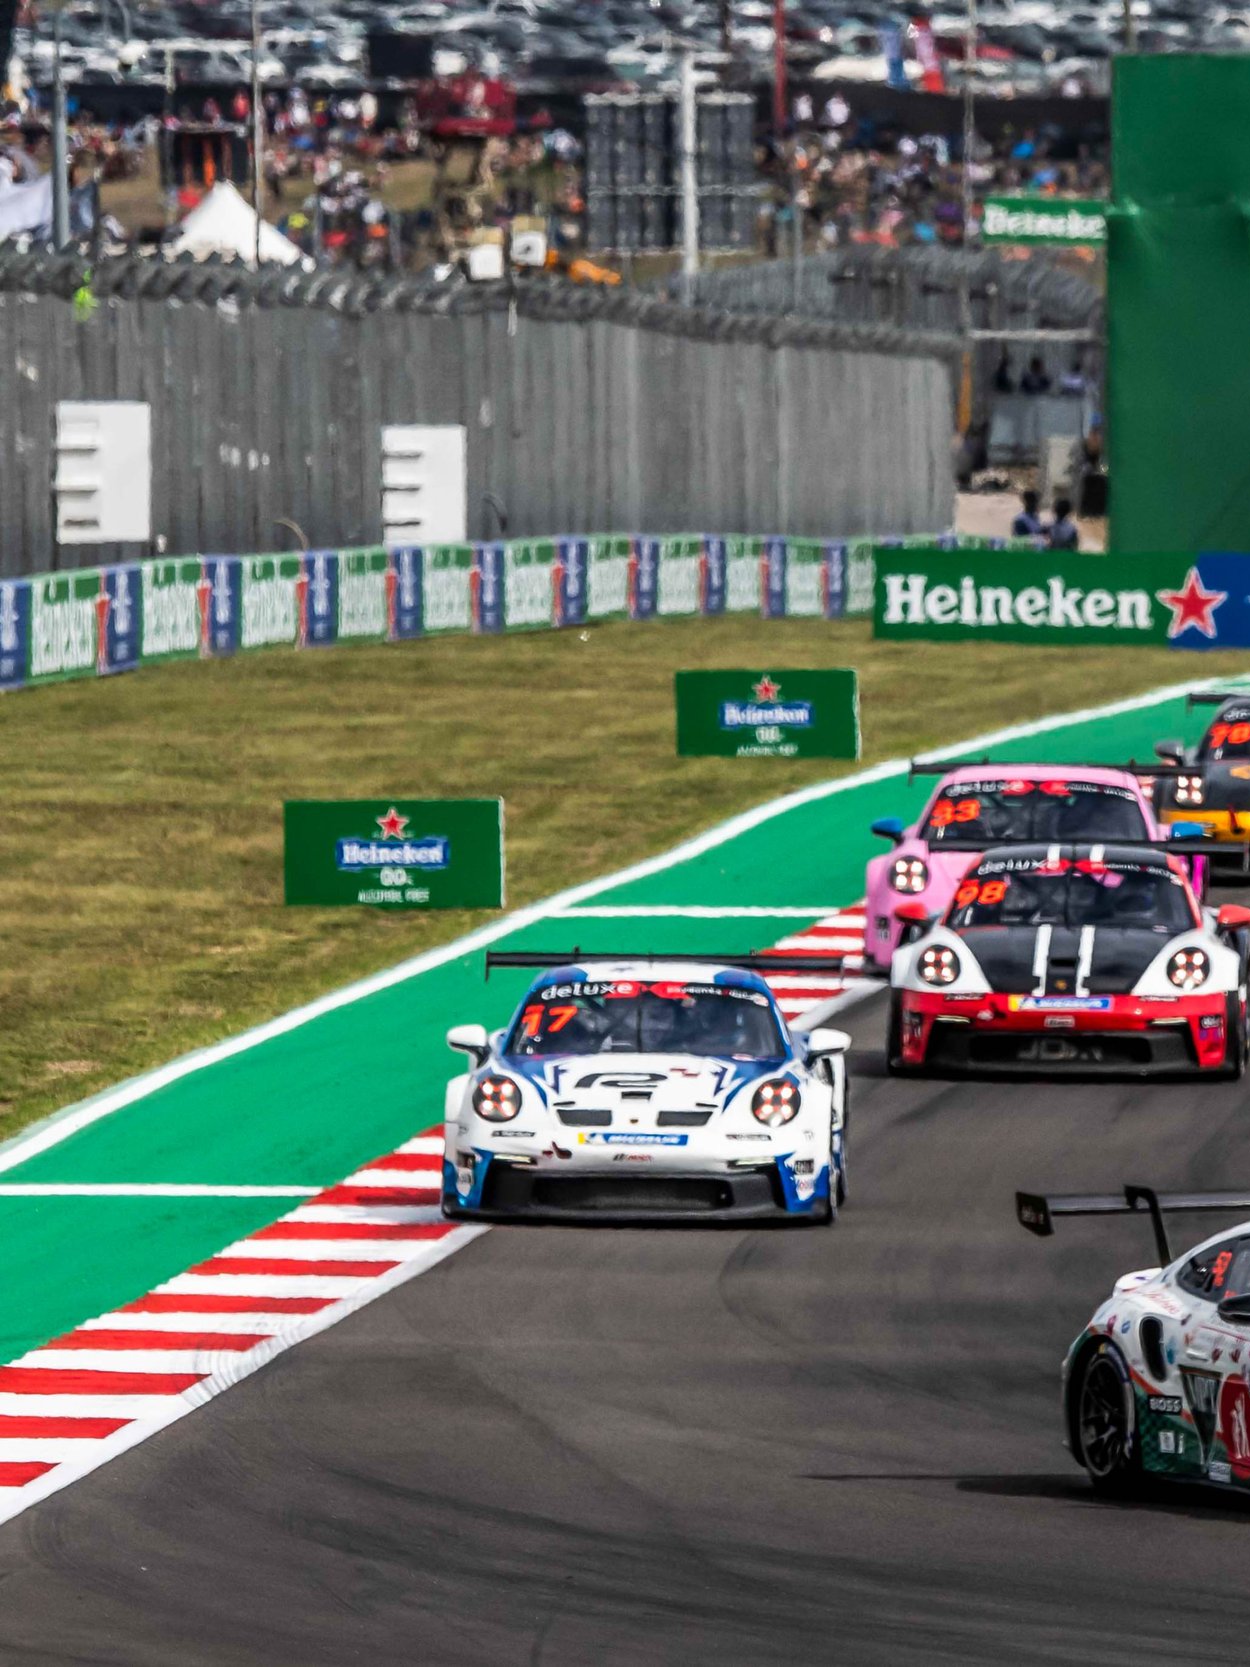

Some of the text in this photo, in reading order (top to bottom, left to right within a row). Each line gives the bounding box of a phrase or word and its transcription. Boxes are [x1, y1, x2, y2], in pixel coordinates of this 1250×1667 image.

[884, 574, 1152, 629] Heineken
[342, 841, 444, 864] Heineken
[541, 982, 633, 1001] deluxe
[522, 1004, 578, 1036] 17
